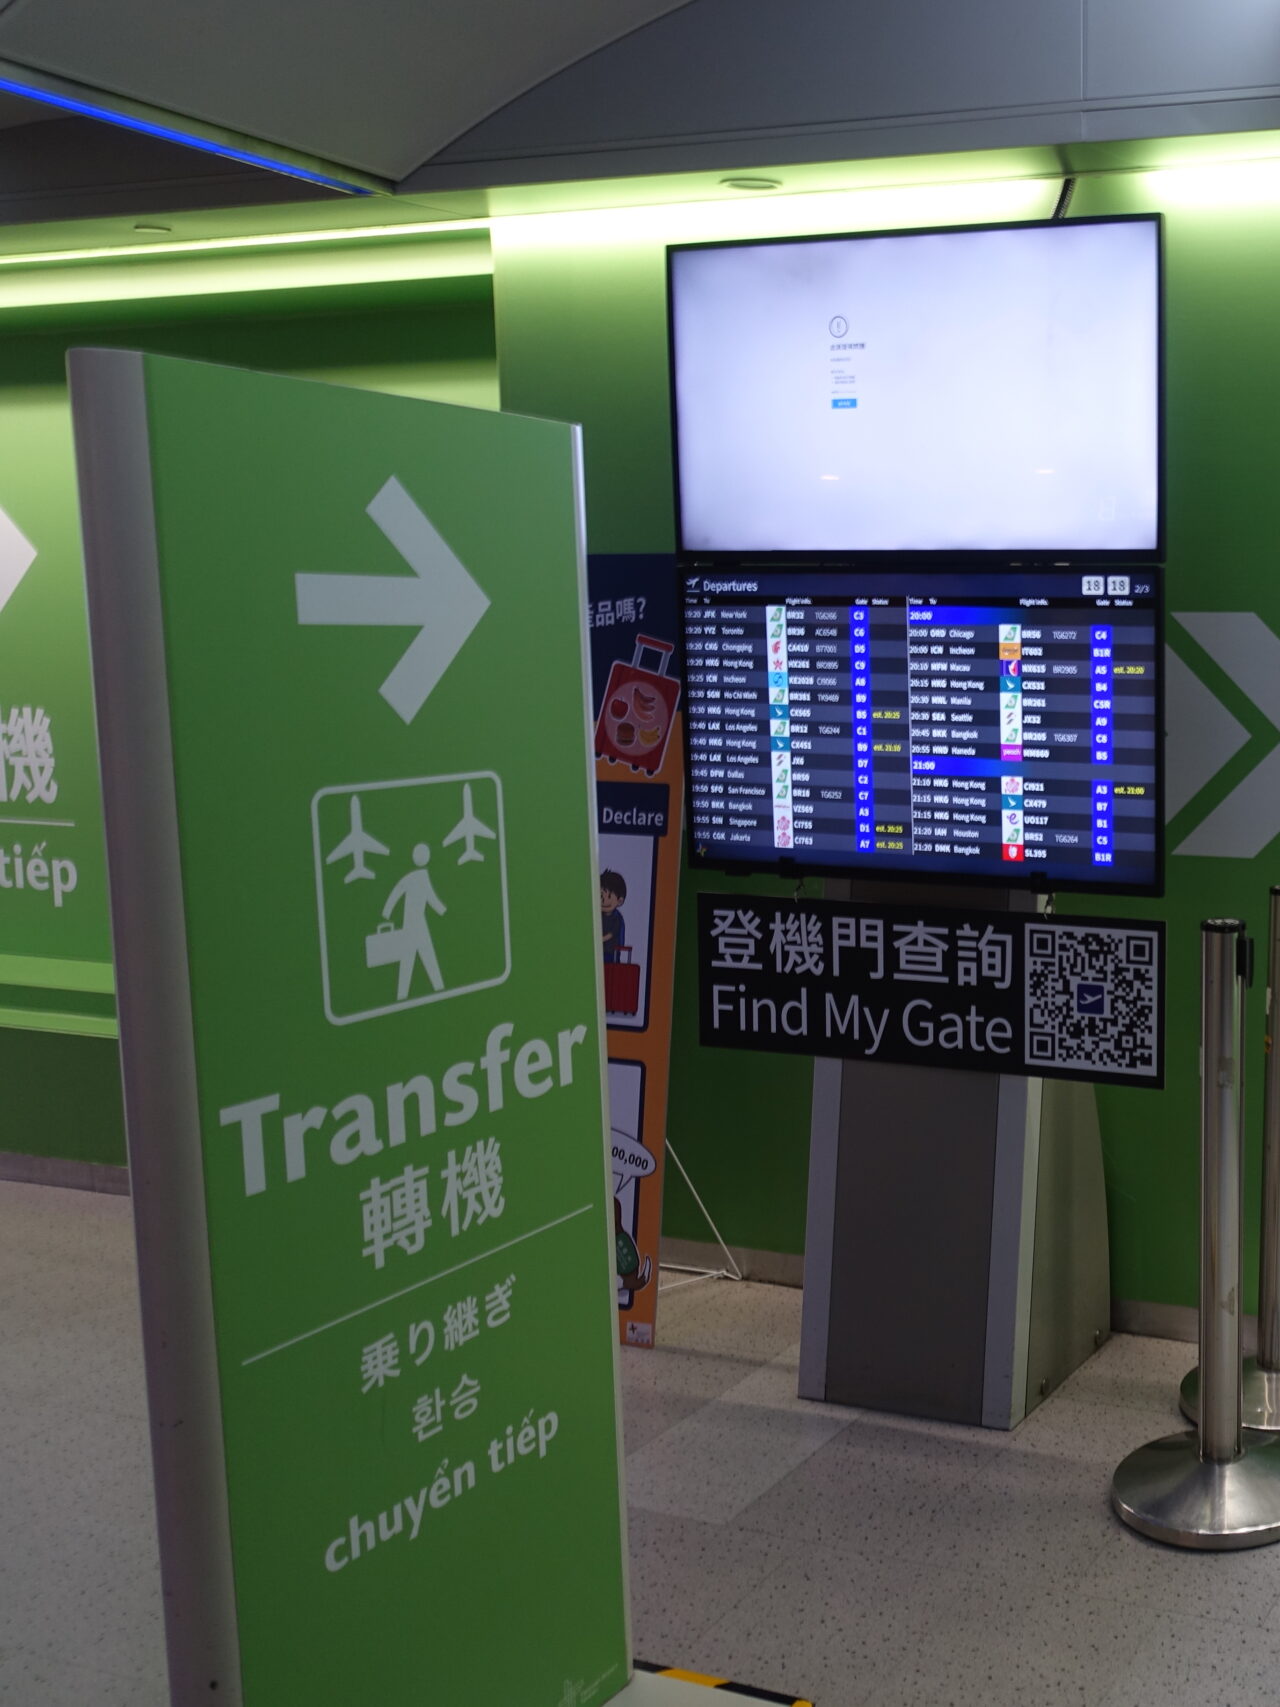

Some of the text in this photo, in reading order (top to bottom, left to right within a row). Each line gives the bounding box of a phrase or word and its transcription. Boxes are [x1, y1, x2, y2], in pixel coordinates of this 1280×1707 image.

[703, 580, 758, 594] Departures
[1086, 580, 1150, 594] 18 18 2/3
[704, 611, 716, 619] JFK
[854, 612, 864, 620] C3
[910, 612, 932, 620] 20:00
[704, 627, 716, 635] YYZ
[909, 630, 927, 638] 20:00
[949, 630, 974, 639] Chicago
[705, 643, 718, 651] CKG
[723, 660, 738, 668] Hong
[738, 660, 753, 669] Kong
[910, 679, 928, 687] 20:15
[931, 680, 946, 688] HKG
[950, 680, 967, 690] Hong
[967, 681, 984, 691] Kong
[911, 696, 929, 704] 20:30
[689, 706, 705, 714] 19:30
[707, 707, 721, 715] HKG
[725, 707, 740, 716] Hong
[740, 708, 755, 717] Kong
[911, 712, 929, 720] 20:30
[932, 713, 945, 721] SEA
[951, 713, 972, 722] Seattle
[736, 724, 757, 733] Angeles
[857, 727, 866, 735] C1
[912, 729, 930, 737] 20:45
[933, 730, 947, 738] BKK
[951, 730, 978, 740] Bangkok
[690, 738, 706, 746] 19:40
[709, 739, 722, 747] HKG
[726, 740, 741, 748] Hong
[741, 740, 756, 749] Kong
[912, 745, 930, 753] 20:55
[952, 747, 975, 755] Haneda
[709, 754, 721, 762] LAX
[738, 756, 759, 764] Angeles
[913, 761, 935, 770] 21:00
[710, 770, 724, 778] DFW
[728, 771, 744, 779] Dallas
[858, 776, 868, 784] C2
[934, 779, 948, 787] HKG
[952, 780, 969, 790] Hong
[969, 781, 985, 791] Kong
[711, 786, 723, 794] SFO
[739, 788, 765, 796] Francisco
[859, 792, 868, 800] C7
[729, 803, 752, 812] Bangkok
[913, 795, 931, 803] 21:15
[934, 796, 948, 804] HKG
[953, 797, 969, 807] Hong
[969, 797, 986, 807] Kong
[1097, 803, 1107, 811] B7
[602, 806, 665, 828] Declare
[934, 812, 949, 820] HKG
[953, 814, 969, 823] Hong
[969, 814, 986, 824] Kong
[1024, 816, 1048, 824] UO117
[1097, 820, 1107, 828] B1
[712, 817, 723, 825] SIN
[729, 819, 757, 828] Singapore
[860, 824, 869, 832] D1
[730, 834, 750, 842] Jakarta
[914, 828, 931, 836] 21:20
[935, 828, 947, 837] IAH
[954, 830, 978, 838] Houston
[914, 844, 932, 852] 21:20
[954, 845, 980, 856] Bangkok
[1095, 854, 1111, 862] B1R
[709, 908, 1013, 990] 登機門查詢
[712, 984, 808, 1036] Find
[825, 992, 889, 1055] My
[219, 1022, 588, 1197] Transfer
[359, 1136, 506, 1270] 轉機
[360, 1273, 516, 1395] 乗り継ぎ
[411, 1373, 481, 1442] 환승
[324, 1408, 559, 1573] chuyển tiếp
